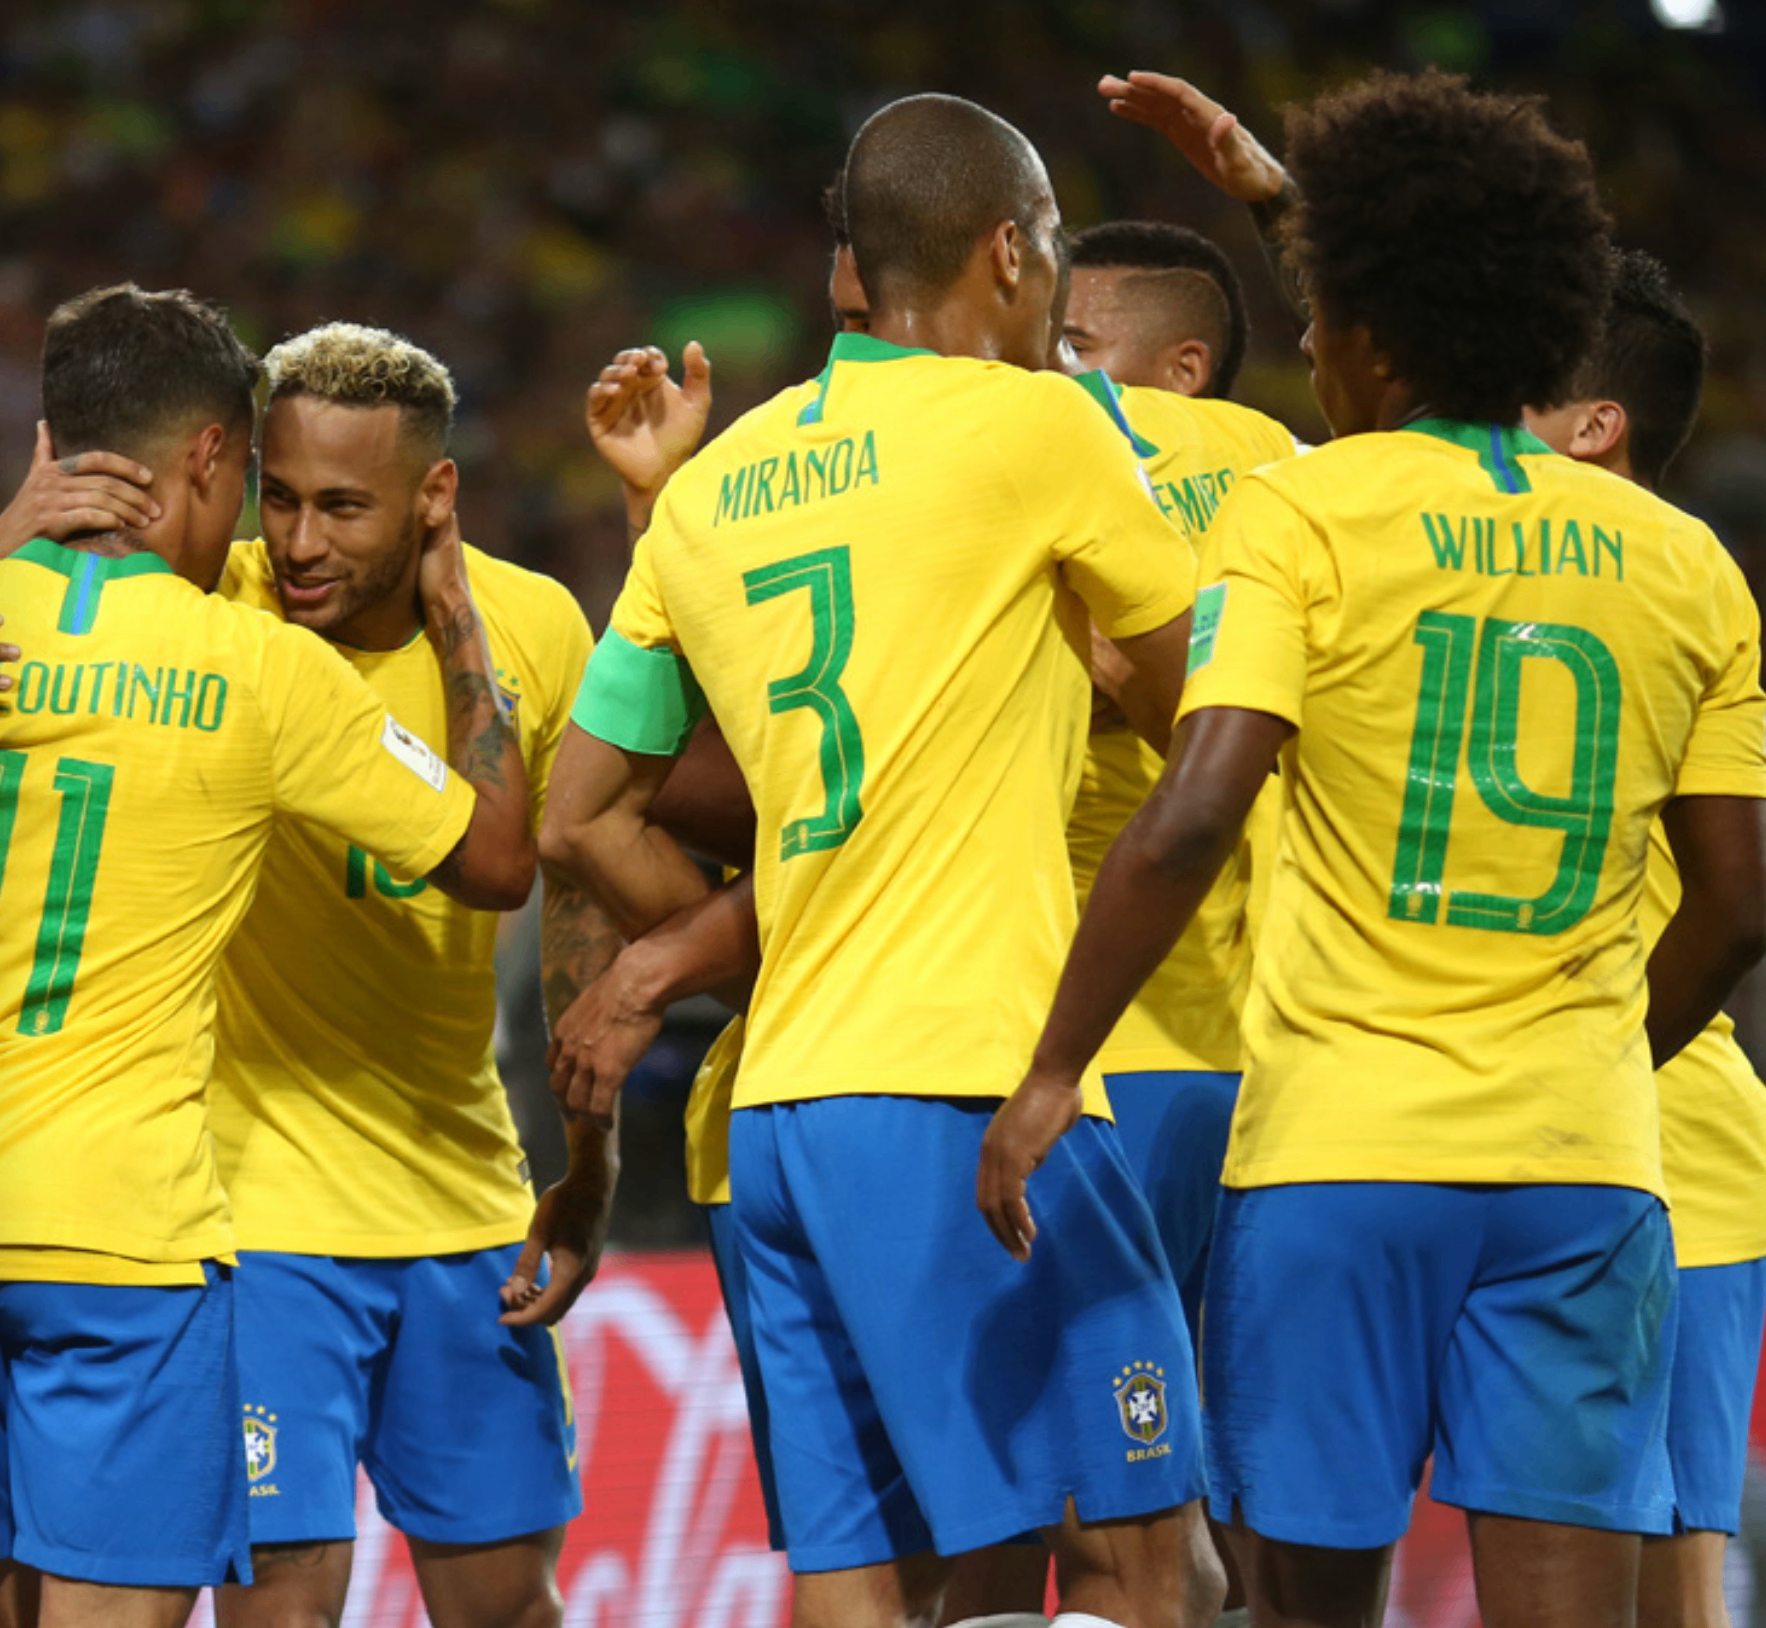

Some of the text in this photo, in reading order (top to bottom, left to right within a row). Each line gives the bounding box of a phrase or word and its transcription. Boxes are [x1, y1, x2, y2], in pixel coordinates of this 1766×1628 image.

[713, 429, 879, 528] MIRANDA
[1420, 511, 1624, 583] WILLIAN
[0, 661, 229, 732] OUTINHO
[742, 545, 865, 862] 3
[1387, 610, 1622, 936] 19
[0, 749, 115, 1036] 1
